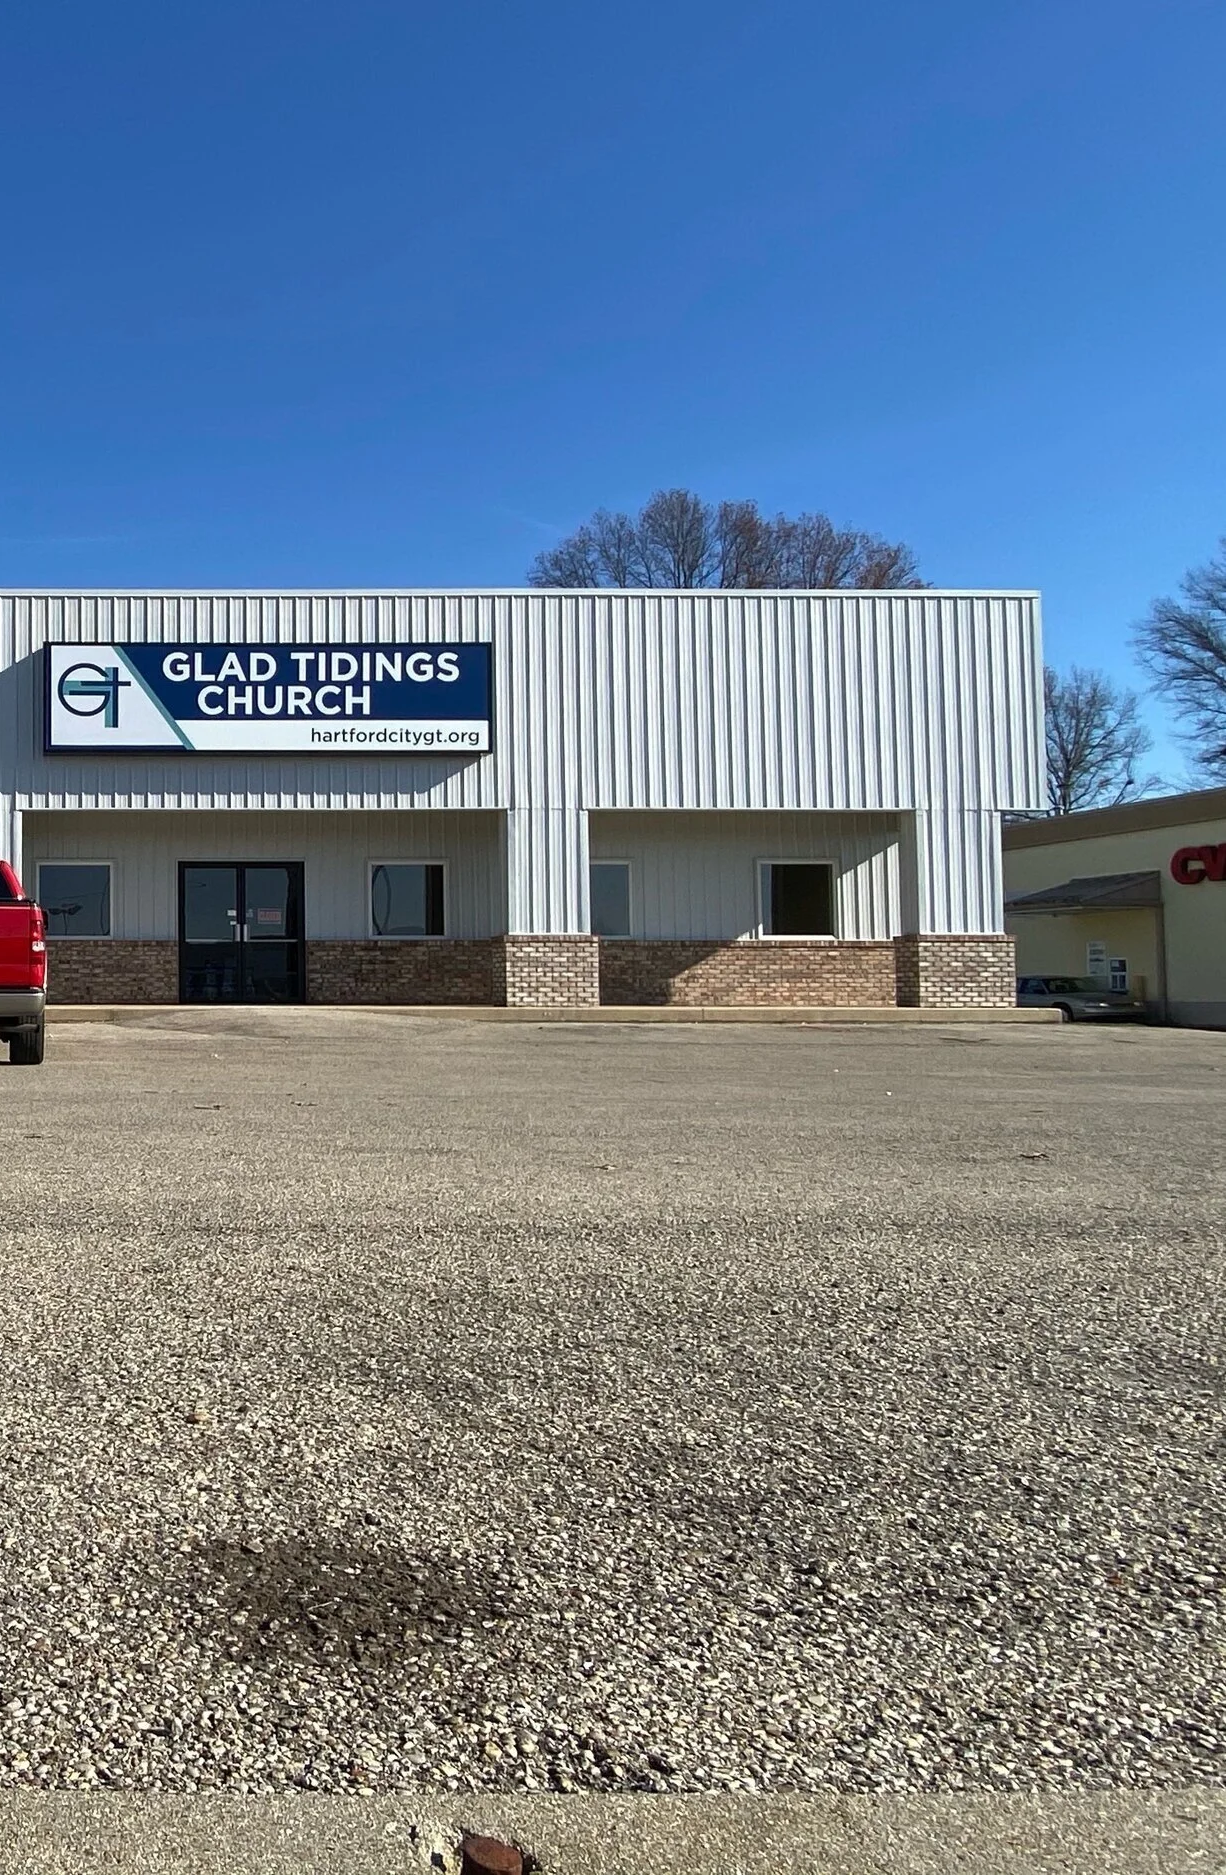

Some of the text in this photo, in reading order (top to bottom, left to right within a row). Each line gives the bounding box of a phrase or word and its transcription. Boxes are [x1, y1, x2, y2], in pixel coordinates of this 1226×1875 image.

[161, 651, 461, 683] GLAD TIDINGS
[196, 684, 372, 716] CHURCH
[310, 727, 481, 746] hartfordcitygt.org
